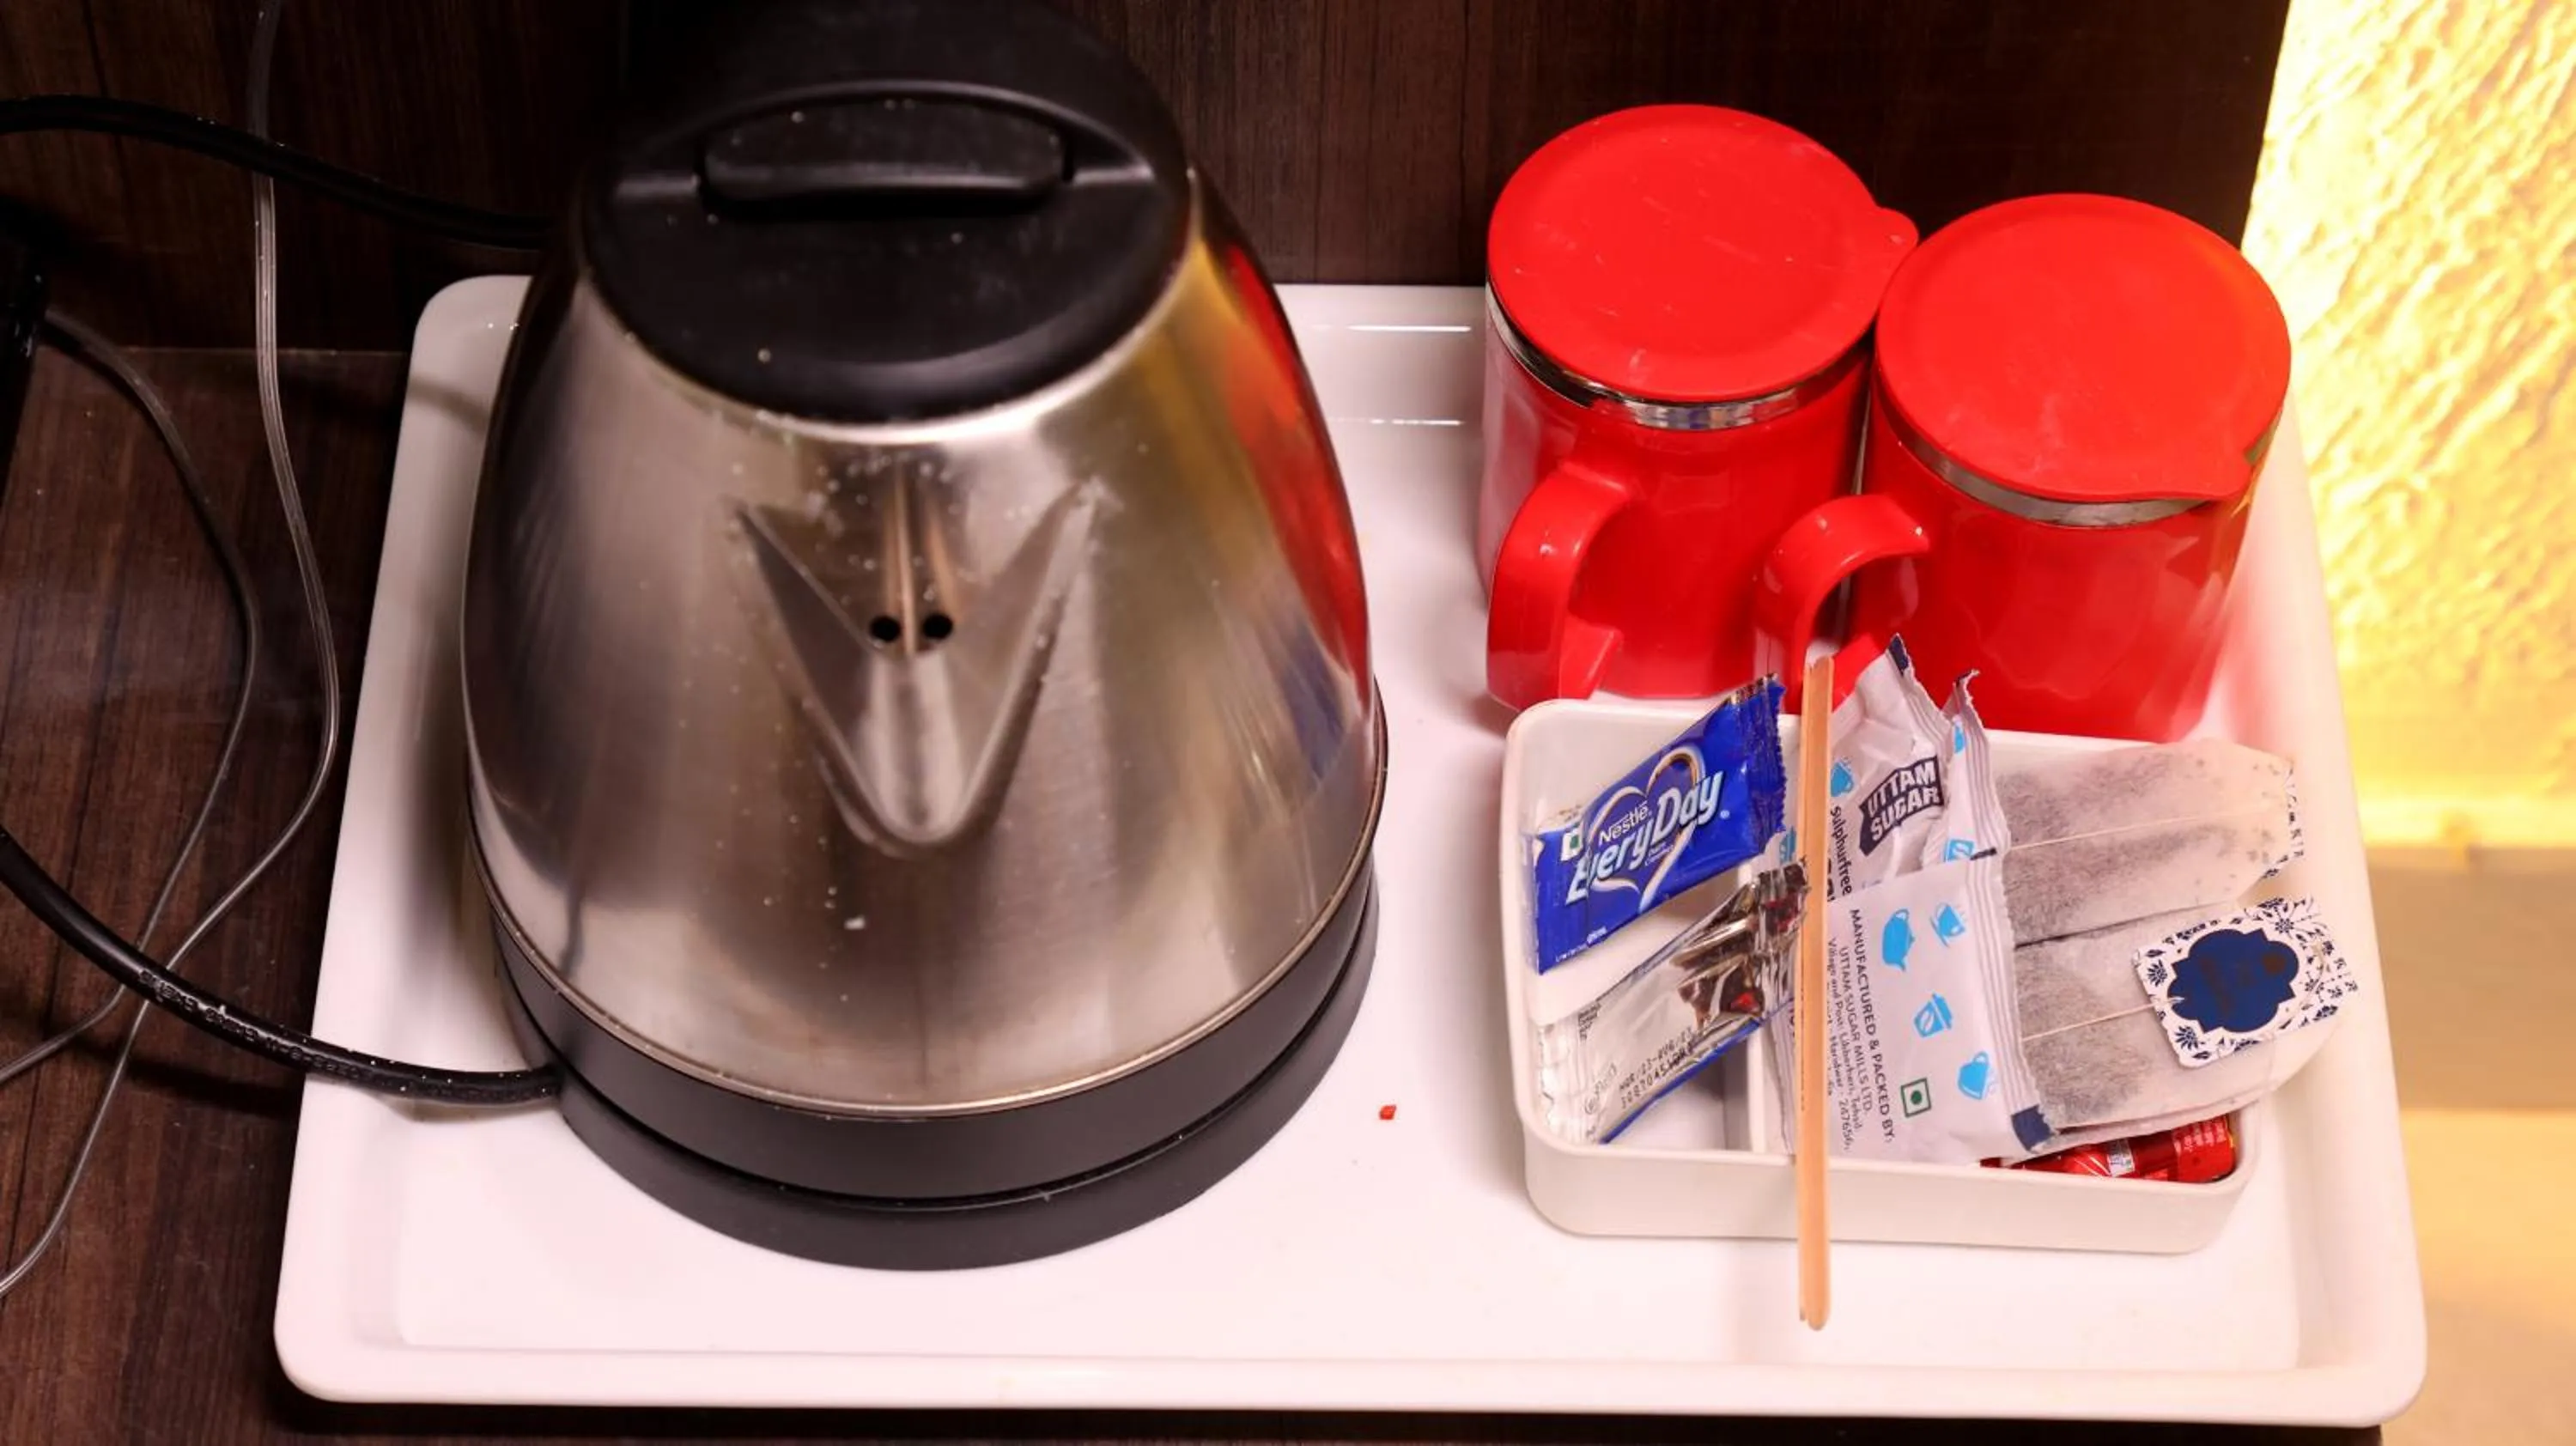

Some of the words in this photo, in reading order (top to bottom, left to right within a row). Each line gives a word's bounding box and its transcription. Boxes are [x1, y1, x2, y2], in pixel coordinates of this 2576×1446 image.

[1867, 760, 1937, 816] UTTAM
[1870, 787, 1941, 841] SUGAR
[1831, 806, 1852, 895] sulphurfree
[1839, 946, 1852, 993] UTTAM
[1850, 909, 1876, 1036] MANUFACTURED
[1844, 993, 1861, 1042] SUGAR
[1868, 1039, 1879, 1050] &
[1854, 1045, 1869, 1084] MILLS
[1872, 1053, 1890, 1115] PACKED
